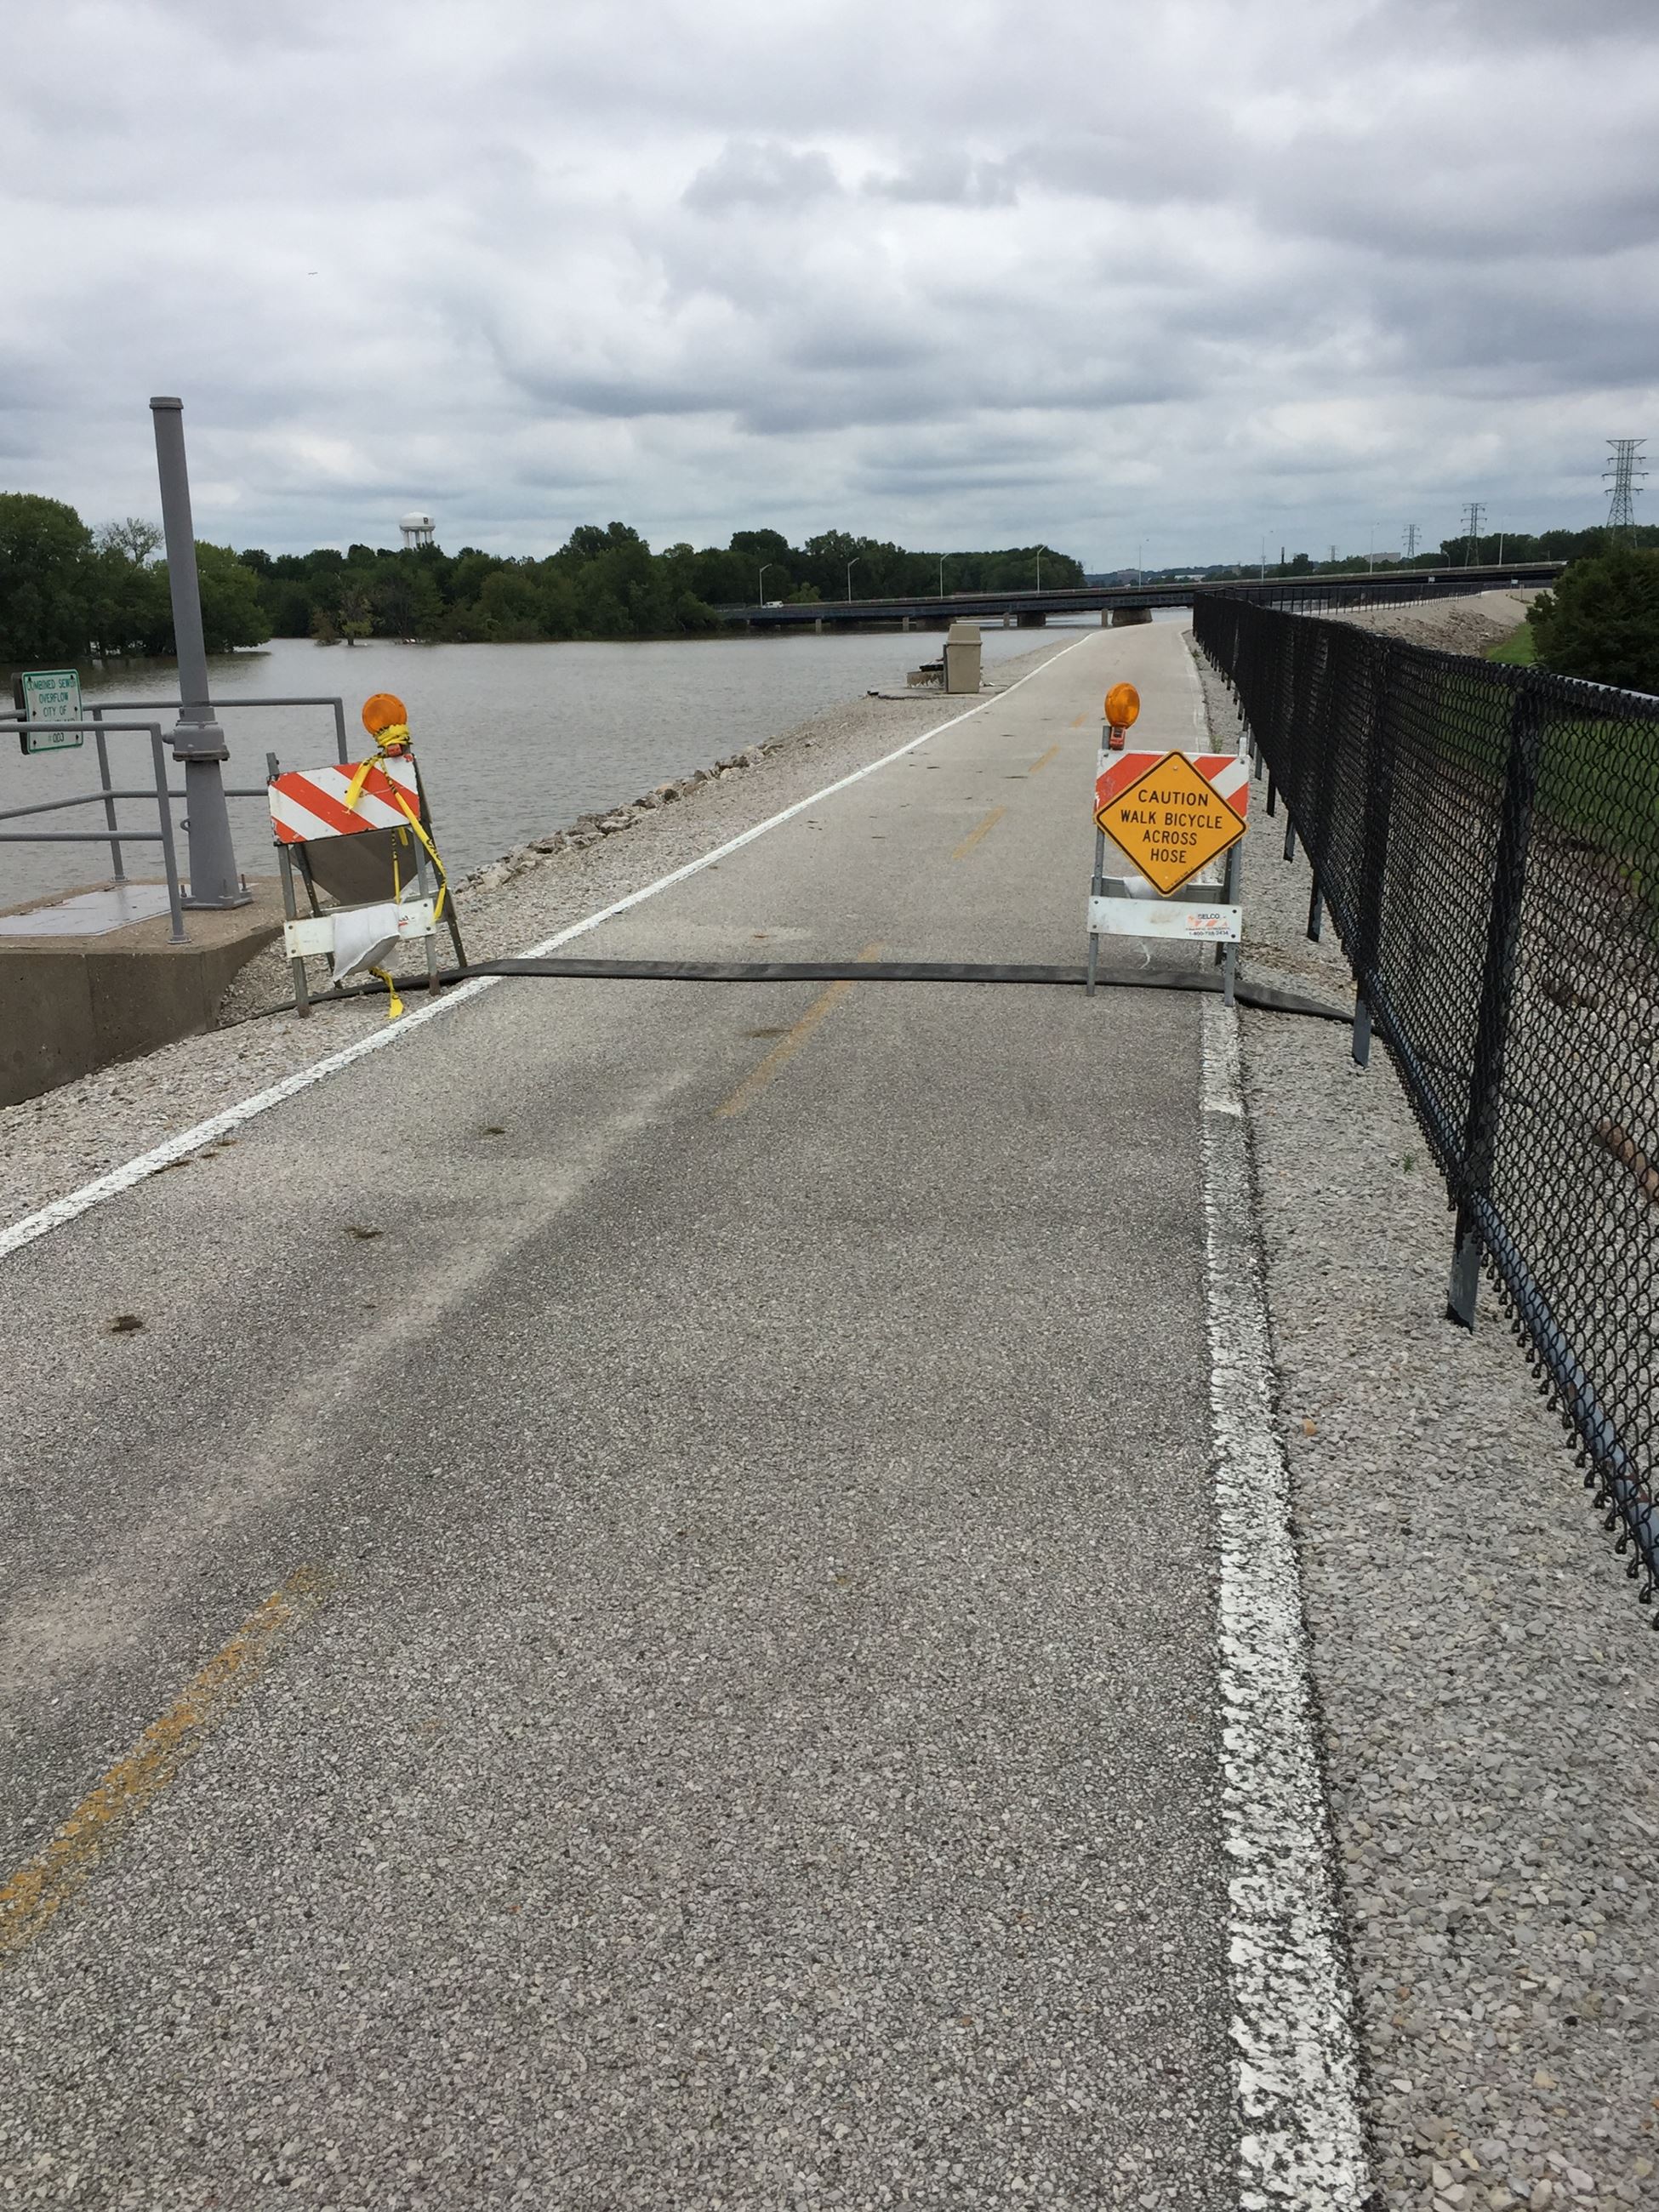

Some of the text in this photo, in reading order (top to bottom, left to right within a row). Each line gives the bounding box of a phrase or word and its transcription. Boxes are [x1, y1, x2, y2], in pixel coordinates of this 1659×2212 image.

[39, 693, 69, 704] OVERFLOW
[43, 705, 67, 717] CITY OF
[1137, 789, 1209, 807] CAUTION
[1120, 809, 1223, 830] WALK BICYCLE
[1143, 830, 1198, 847] ACROSS
[1150, 848, 1187, 864] HOSE
